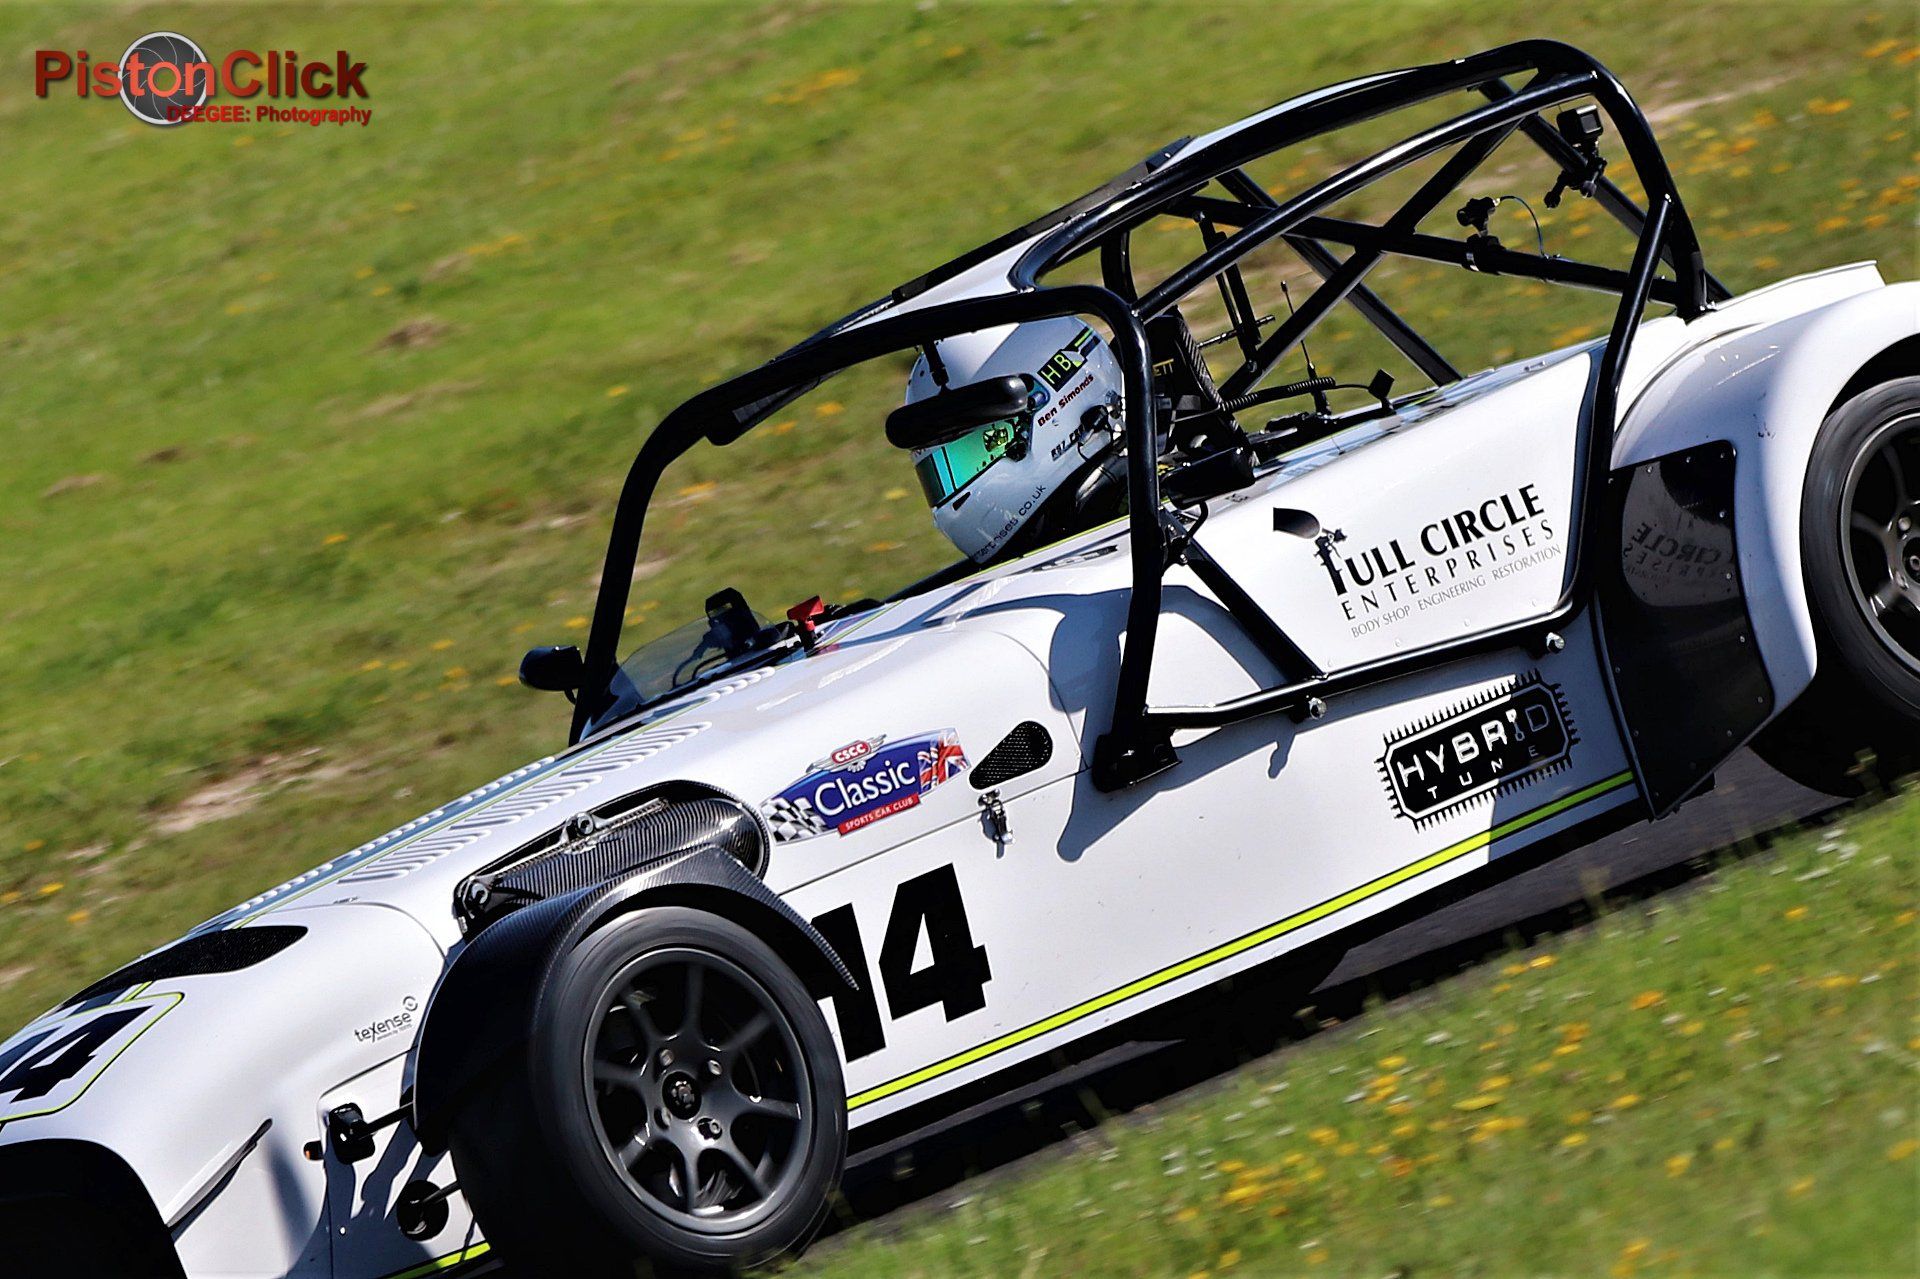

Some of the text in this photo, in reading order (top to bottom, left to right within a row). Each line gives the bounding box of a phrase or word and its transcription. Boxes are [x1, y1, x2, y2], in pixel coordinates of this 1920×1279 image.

[1037, 373, 1095, 427] Ben Simonds
[1420, 483, 1545, 557] CIRCLE
[1341, 519, 1554, 621] ENTERPRISES
[1350, 543, 1562, 638] BODY SHOP ENGINEERING RESTORATION
[834, 743, 867, 764] CSCC
[1397, 703, 1550, 788] HYBRID
[1427, 745, 1538, 800] TUNE
[814, 760, 916, 816] Classic
[845, 797, 914, 830] SPORTS CAR CLUB
[810, 862, 993, 1065] 14
